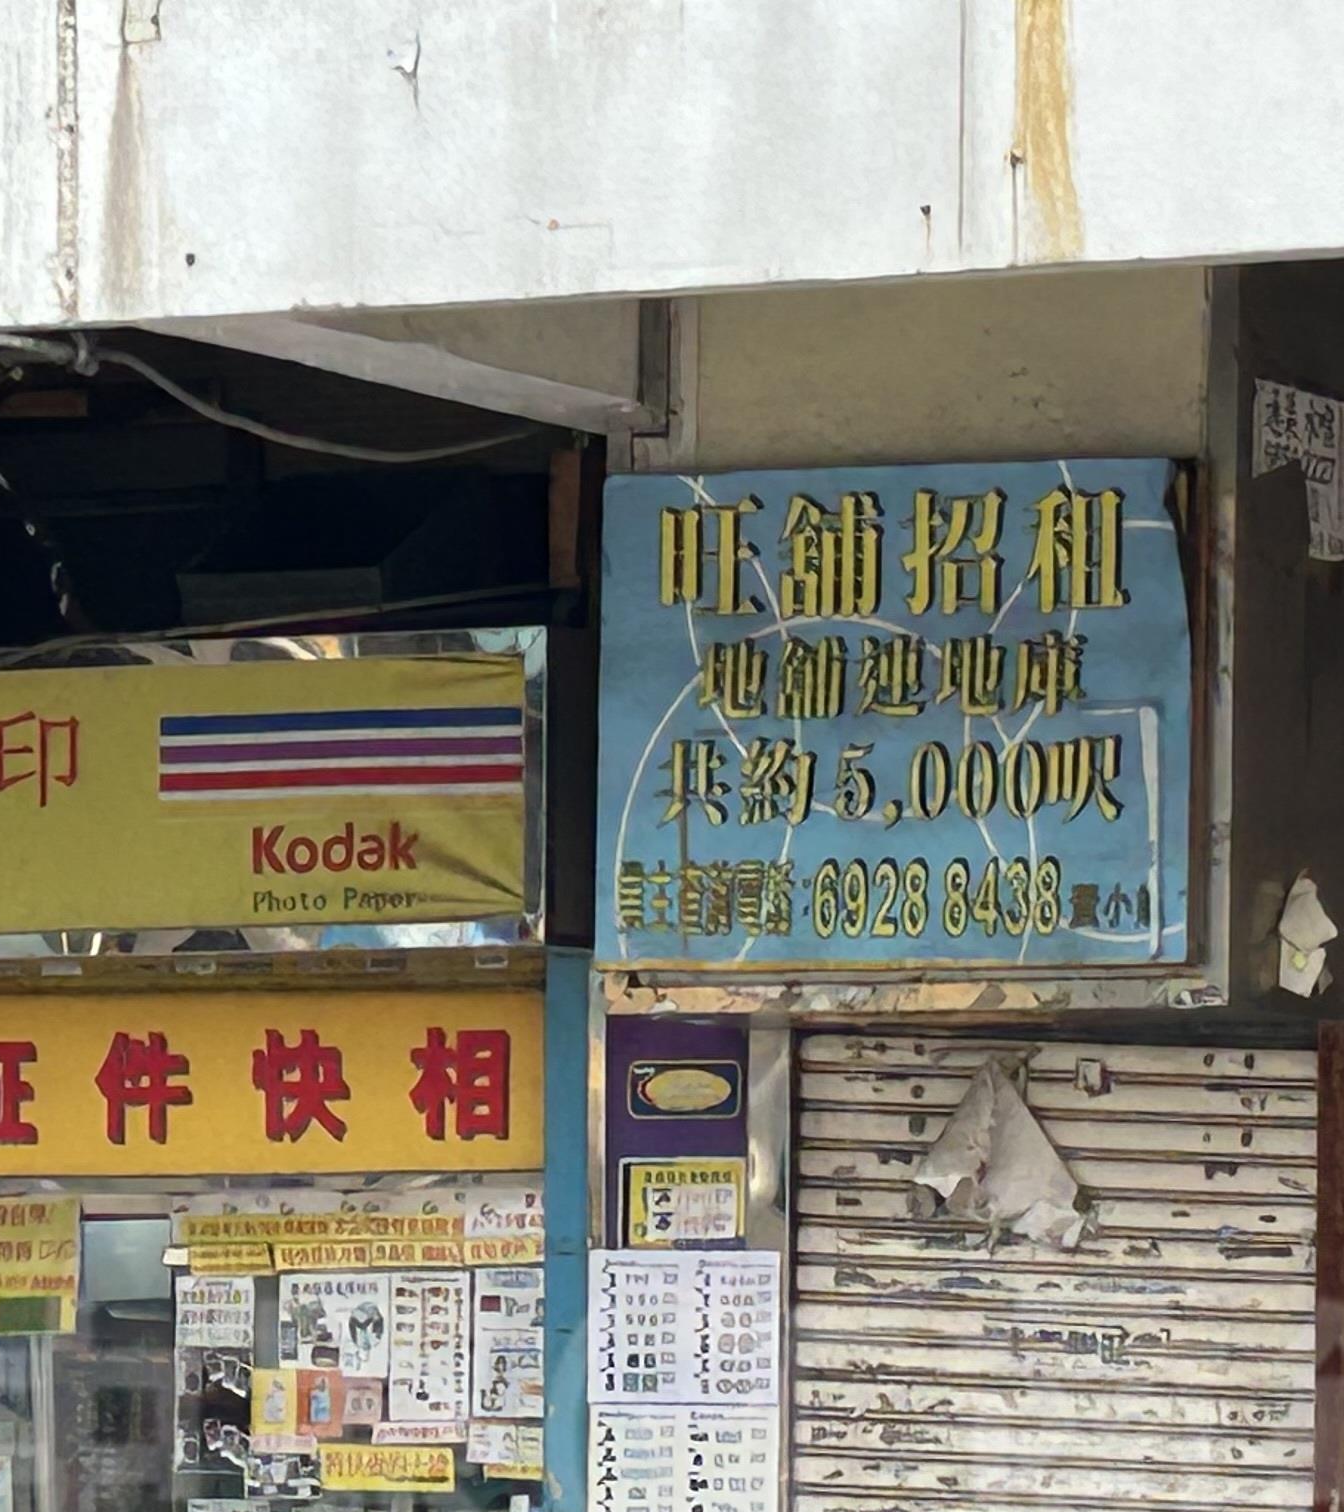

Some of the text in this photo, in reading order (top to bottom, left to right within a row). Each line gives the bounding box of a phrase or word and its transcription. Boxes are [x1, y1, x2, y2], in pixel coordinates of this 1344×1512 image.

[660, 486, 1132, 618] 旺舖招租
[251, 820, 420, 875] Kodak
[812, 857, 933, 939] 6928
[942, 856, 1062, 938] 8438
